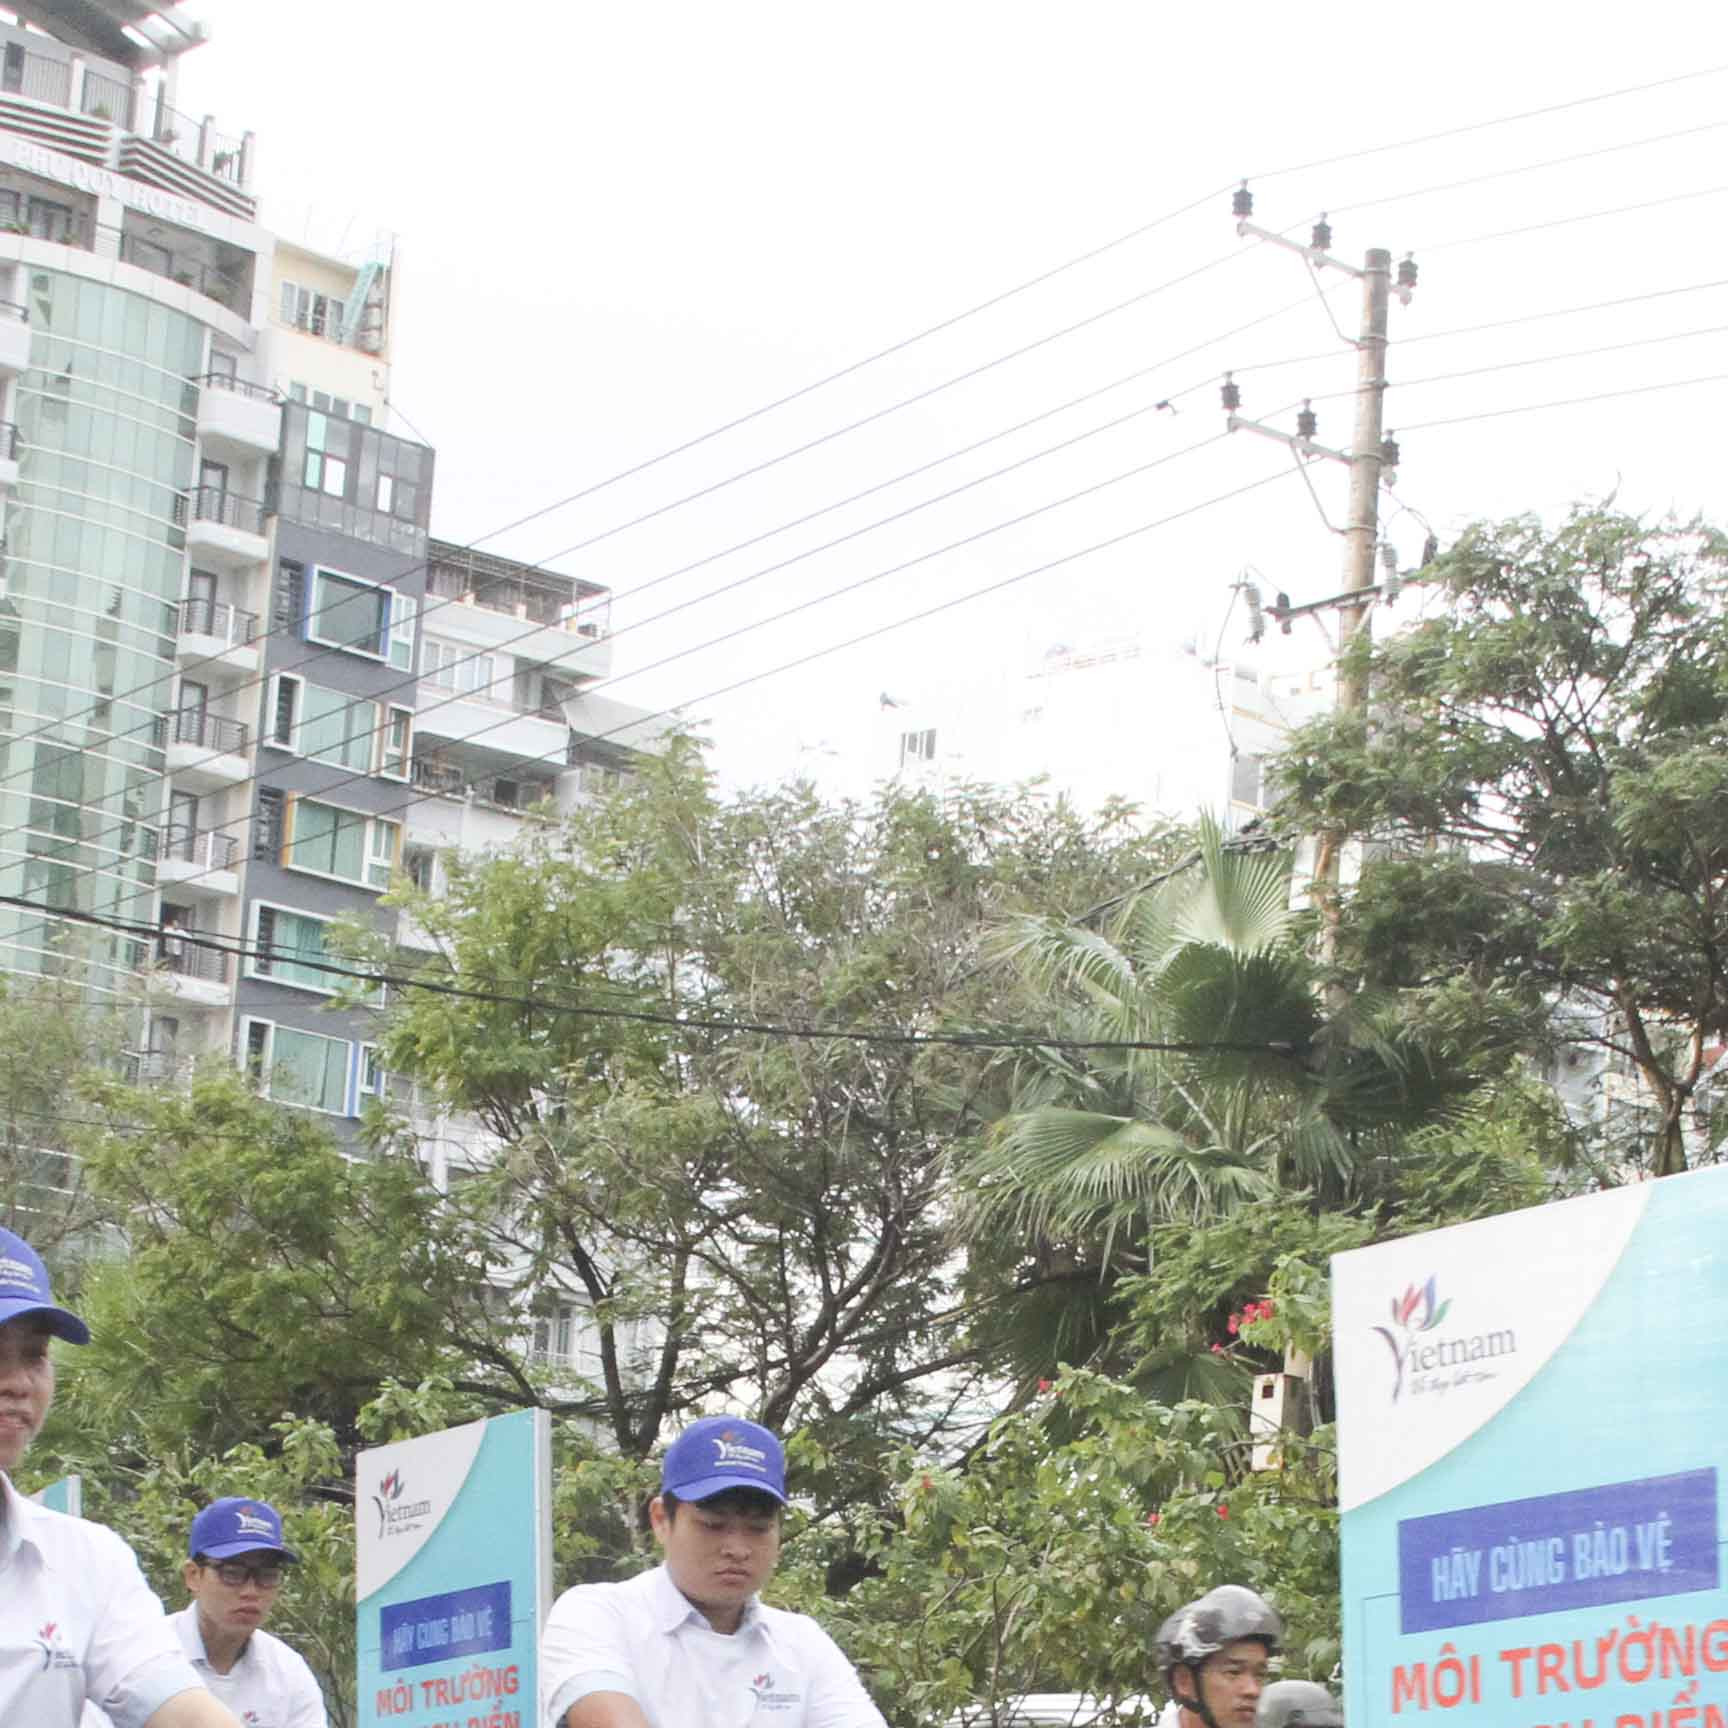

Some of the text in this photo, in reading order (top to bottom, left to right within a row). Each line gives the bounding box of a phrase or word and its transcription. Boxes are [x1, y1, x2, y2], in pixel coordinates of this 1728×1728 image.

[1370, 1325, 1518, 1405] Vietnam
[1431, 1547, 1483, 1603] HÃY
[1489, 1535, 1567, 1594] CÙNG
[1635, 1510, 1674, 1575] VỆ
[376, 1677, 414, 1718] MÔI
[1391, 1642, 1481, 1715] MÔI
